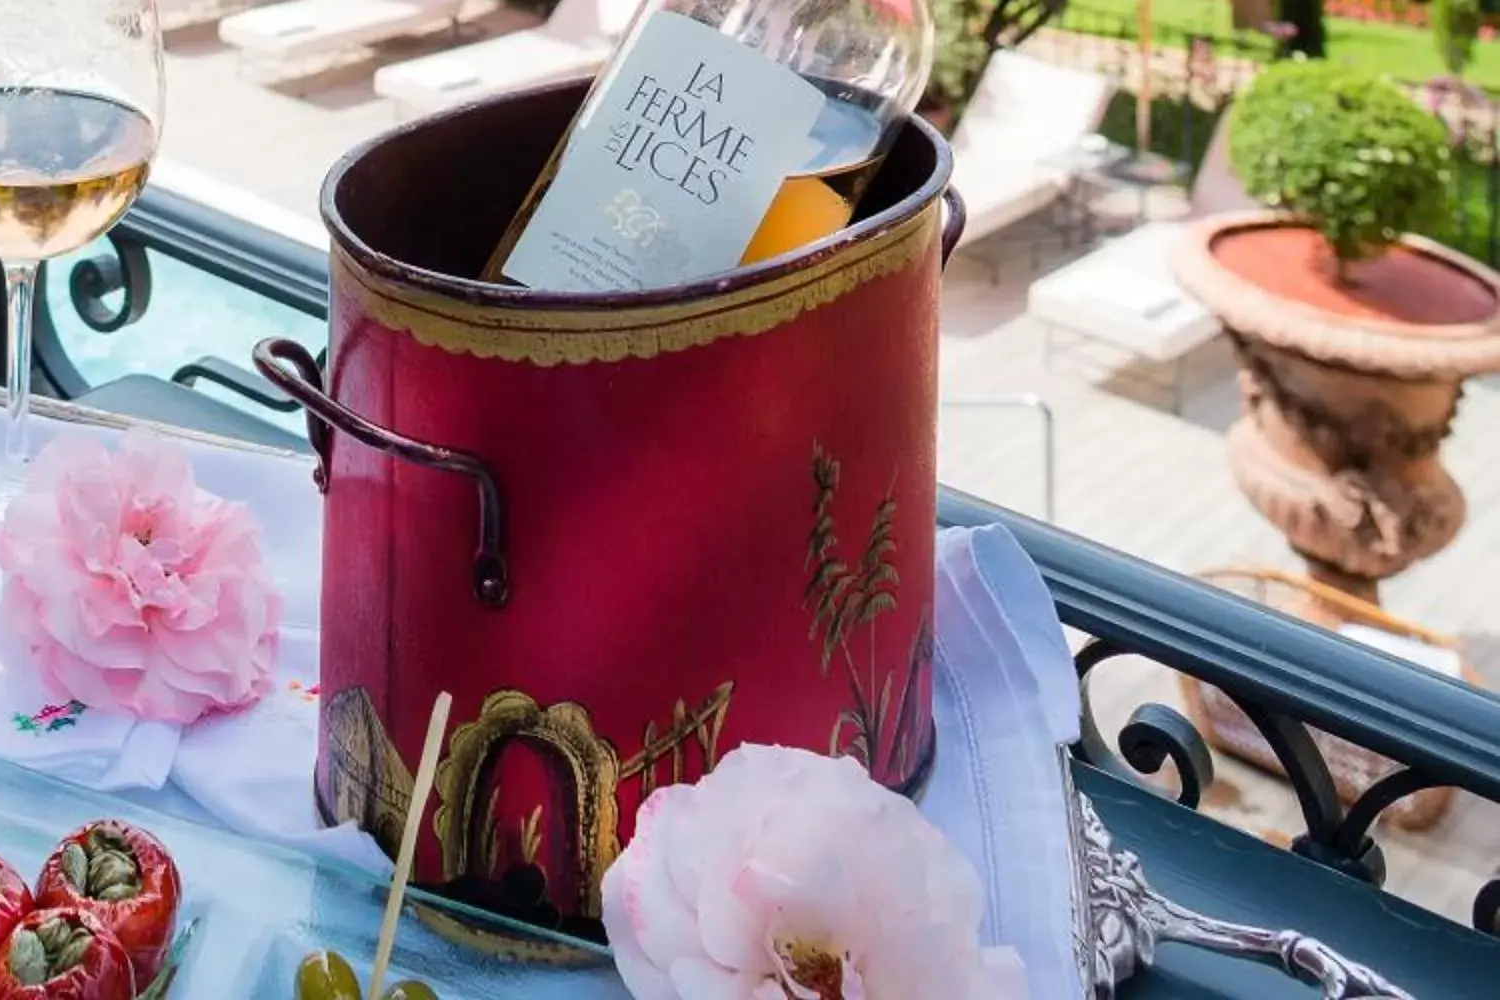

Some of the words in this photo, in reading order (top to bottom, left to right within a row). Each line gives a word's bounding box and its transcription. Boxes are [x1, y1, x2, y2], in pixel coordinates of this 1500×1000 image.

[684, 62, 723, 103] LA
[615, 124, 728, 205] LICES
[624, 75, 755, 173] FERME
